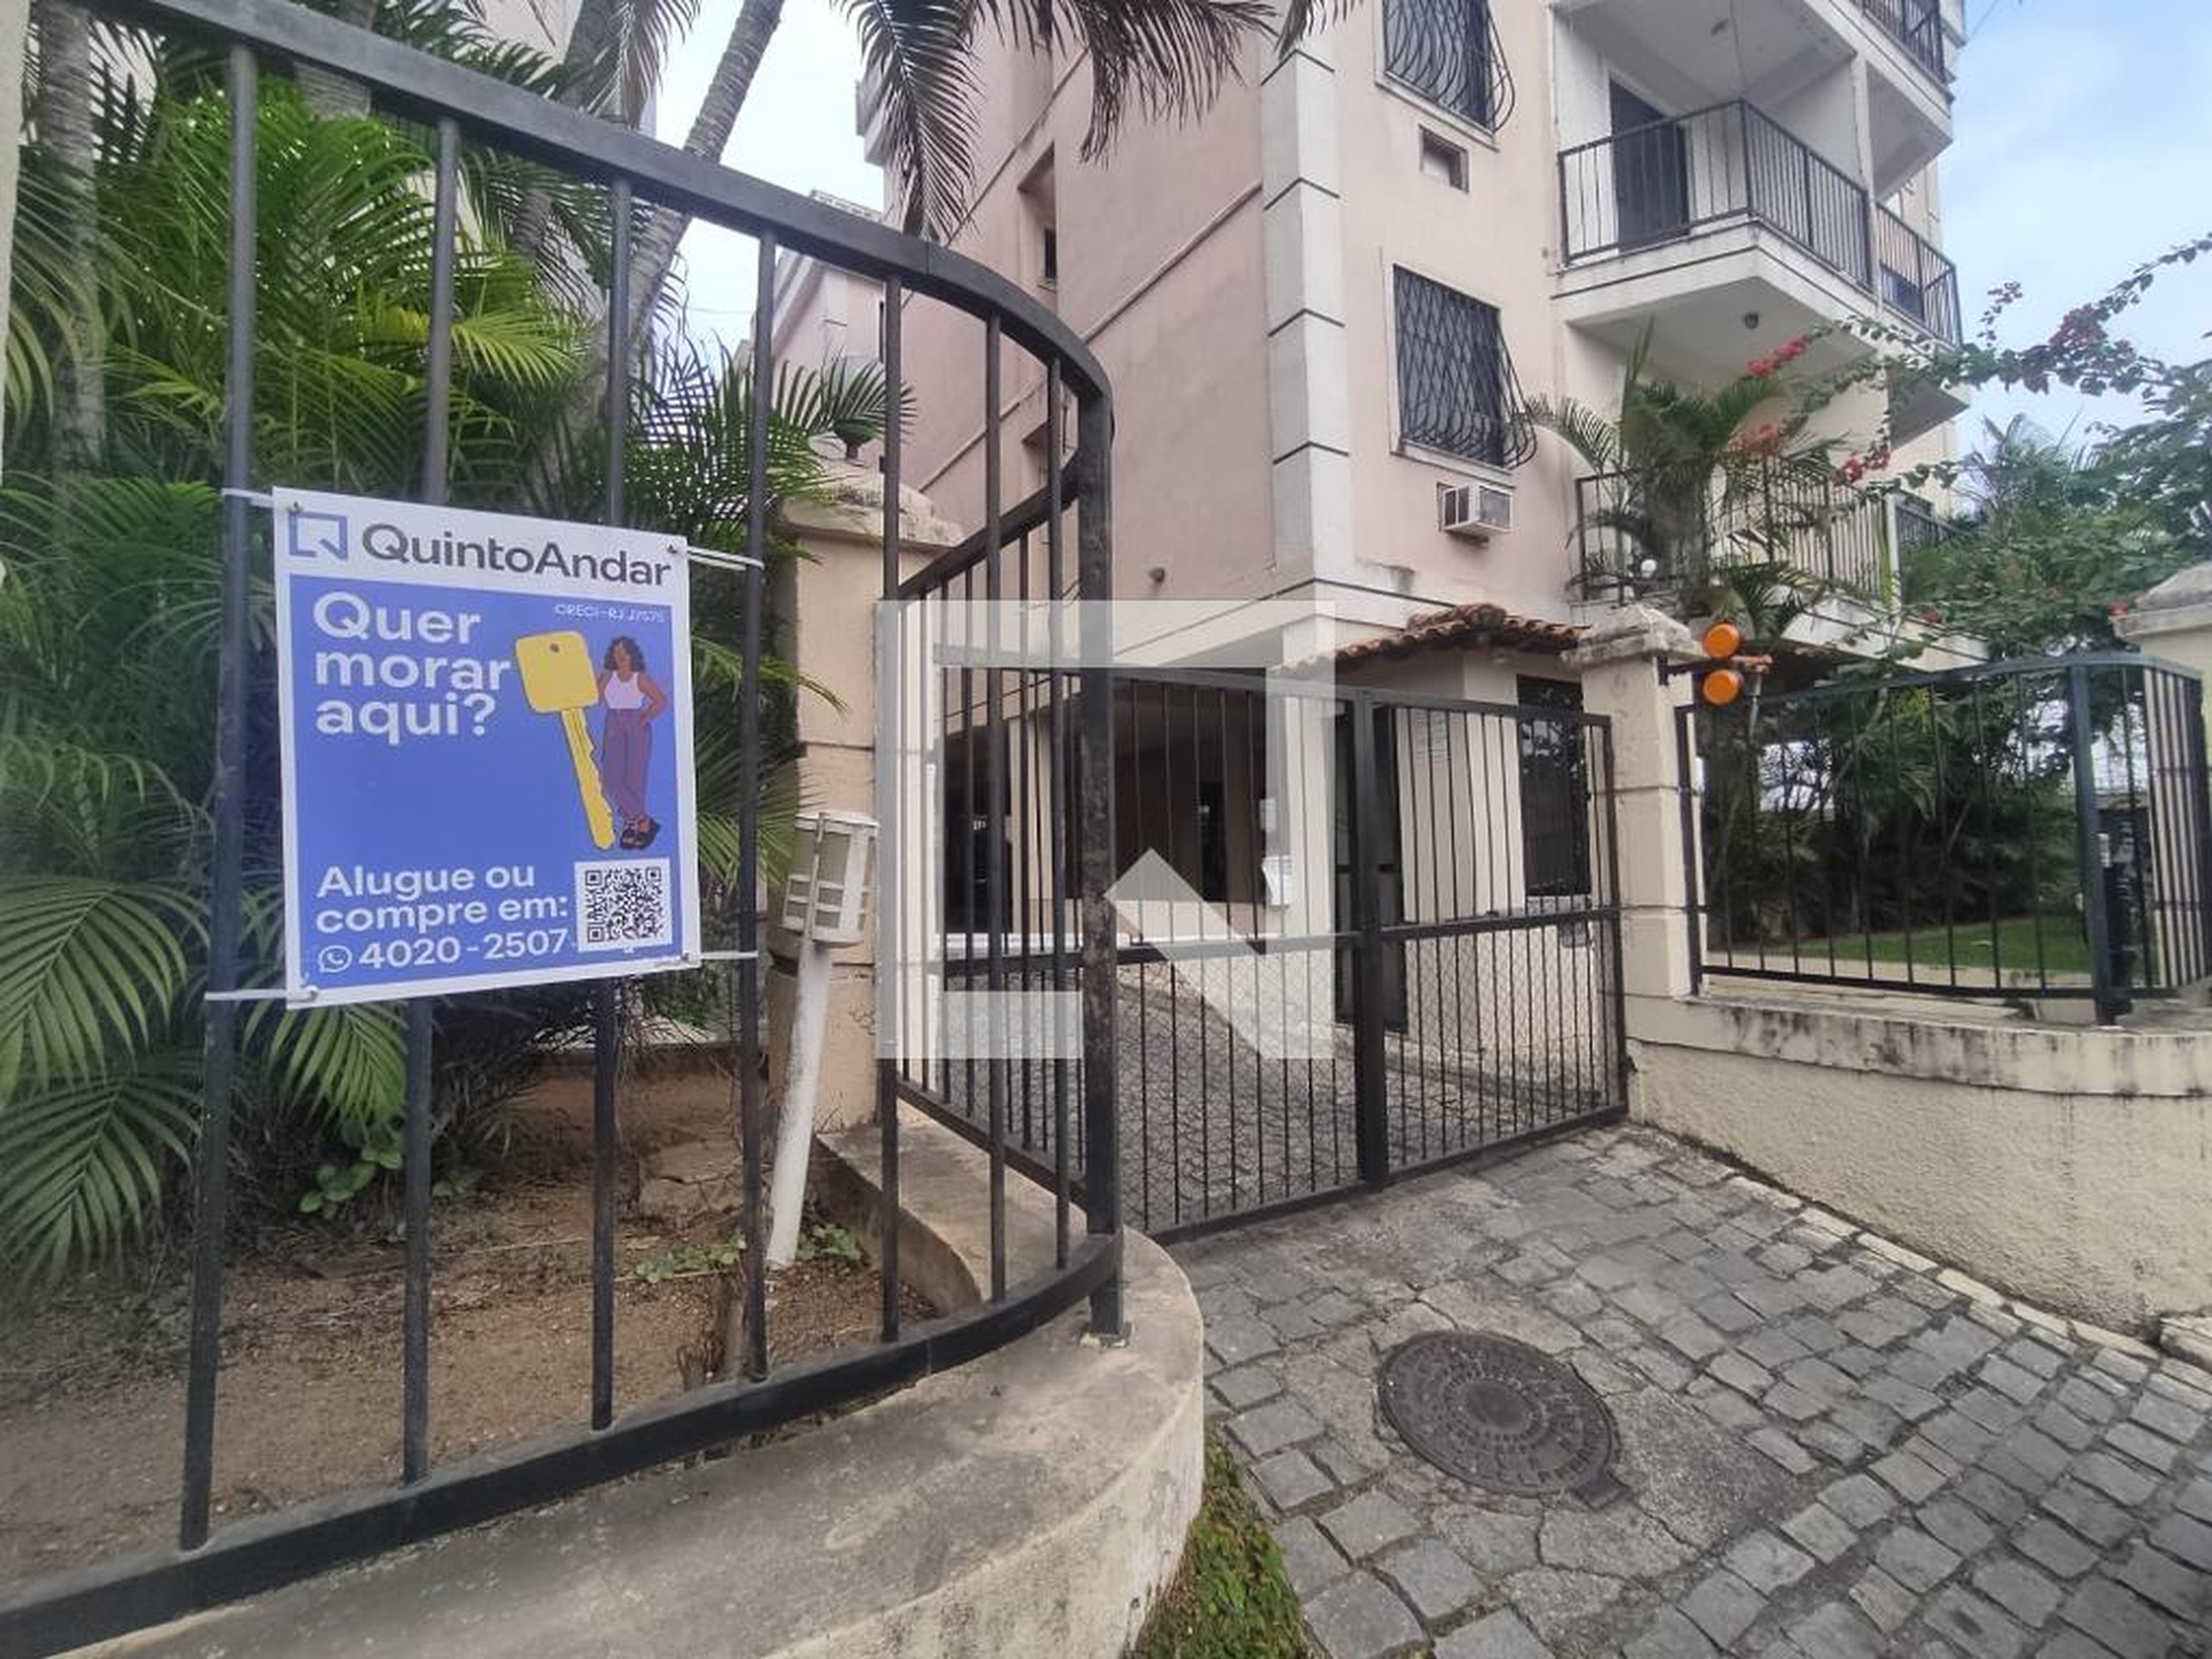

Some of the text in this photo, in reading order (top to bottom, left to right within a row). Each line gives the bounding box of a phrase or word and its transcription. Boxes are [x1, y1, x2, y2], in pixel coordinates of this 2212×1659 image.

[362, 523, 671, 586] QuintoAndar
[313, 592, 482, 644] Quer
[315, 652, 512, 691] morar
[316, 691, 496, 745] aqui?
[316, 866, 535, 901] Alugue ou
[316, 896, 568, 934] compre em:
[358, 927, 569, 969] 4020-2507
